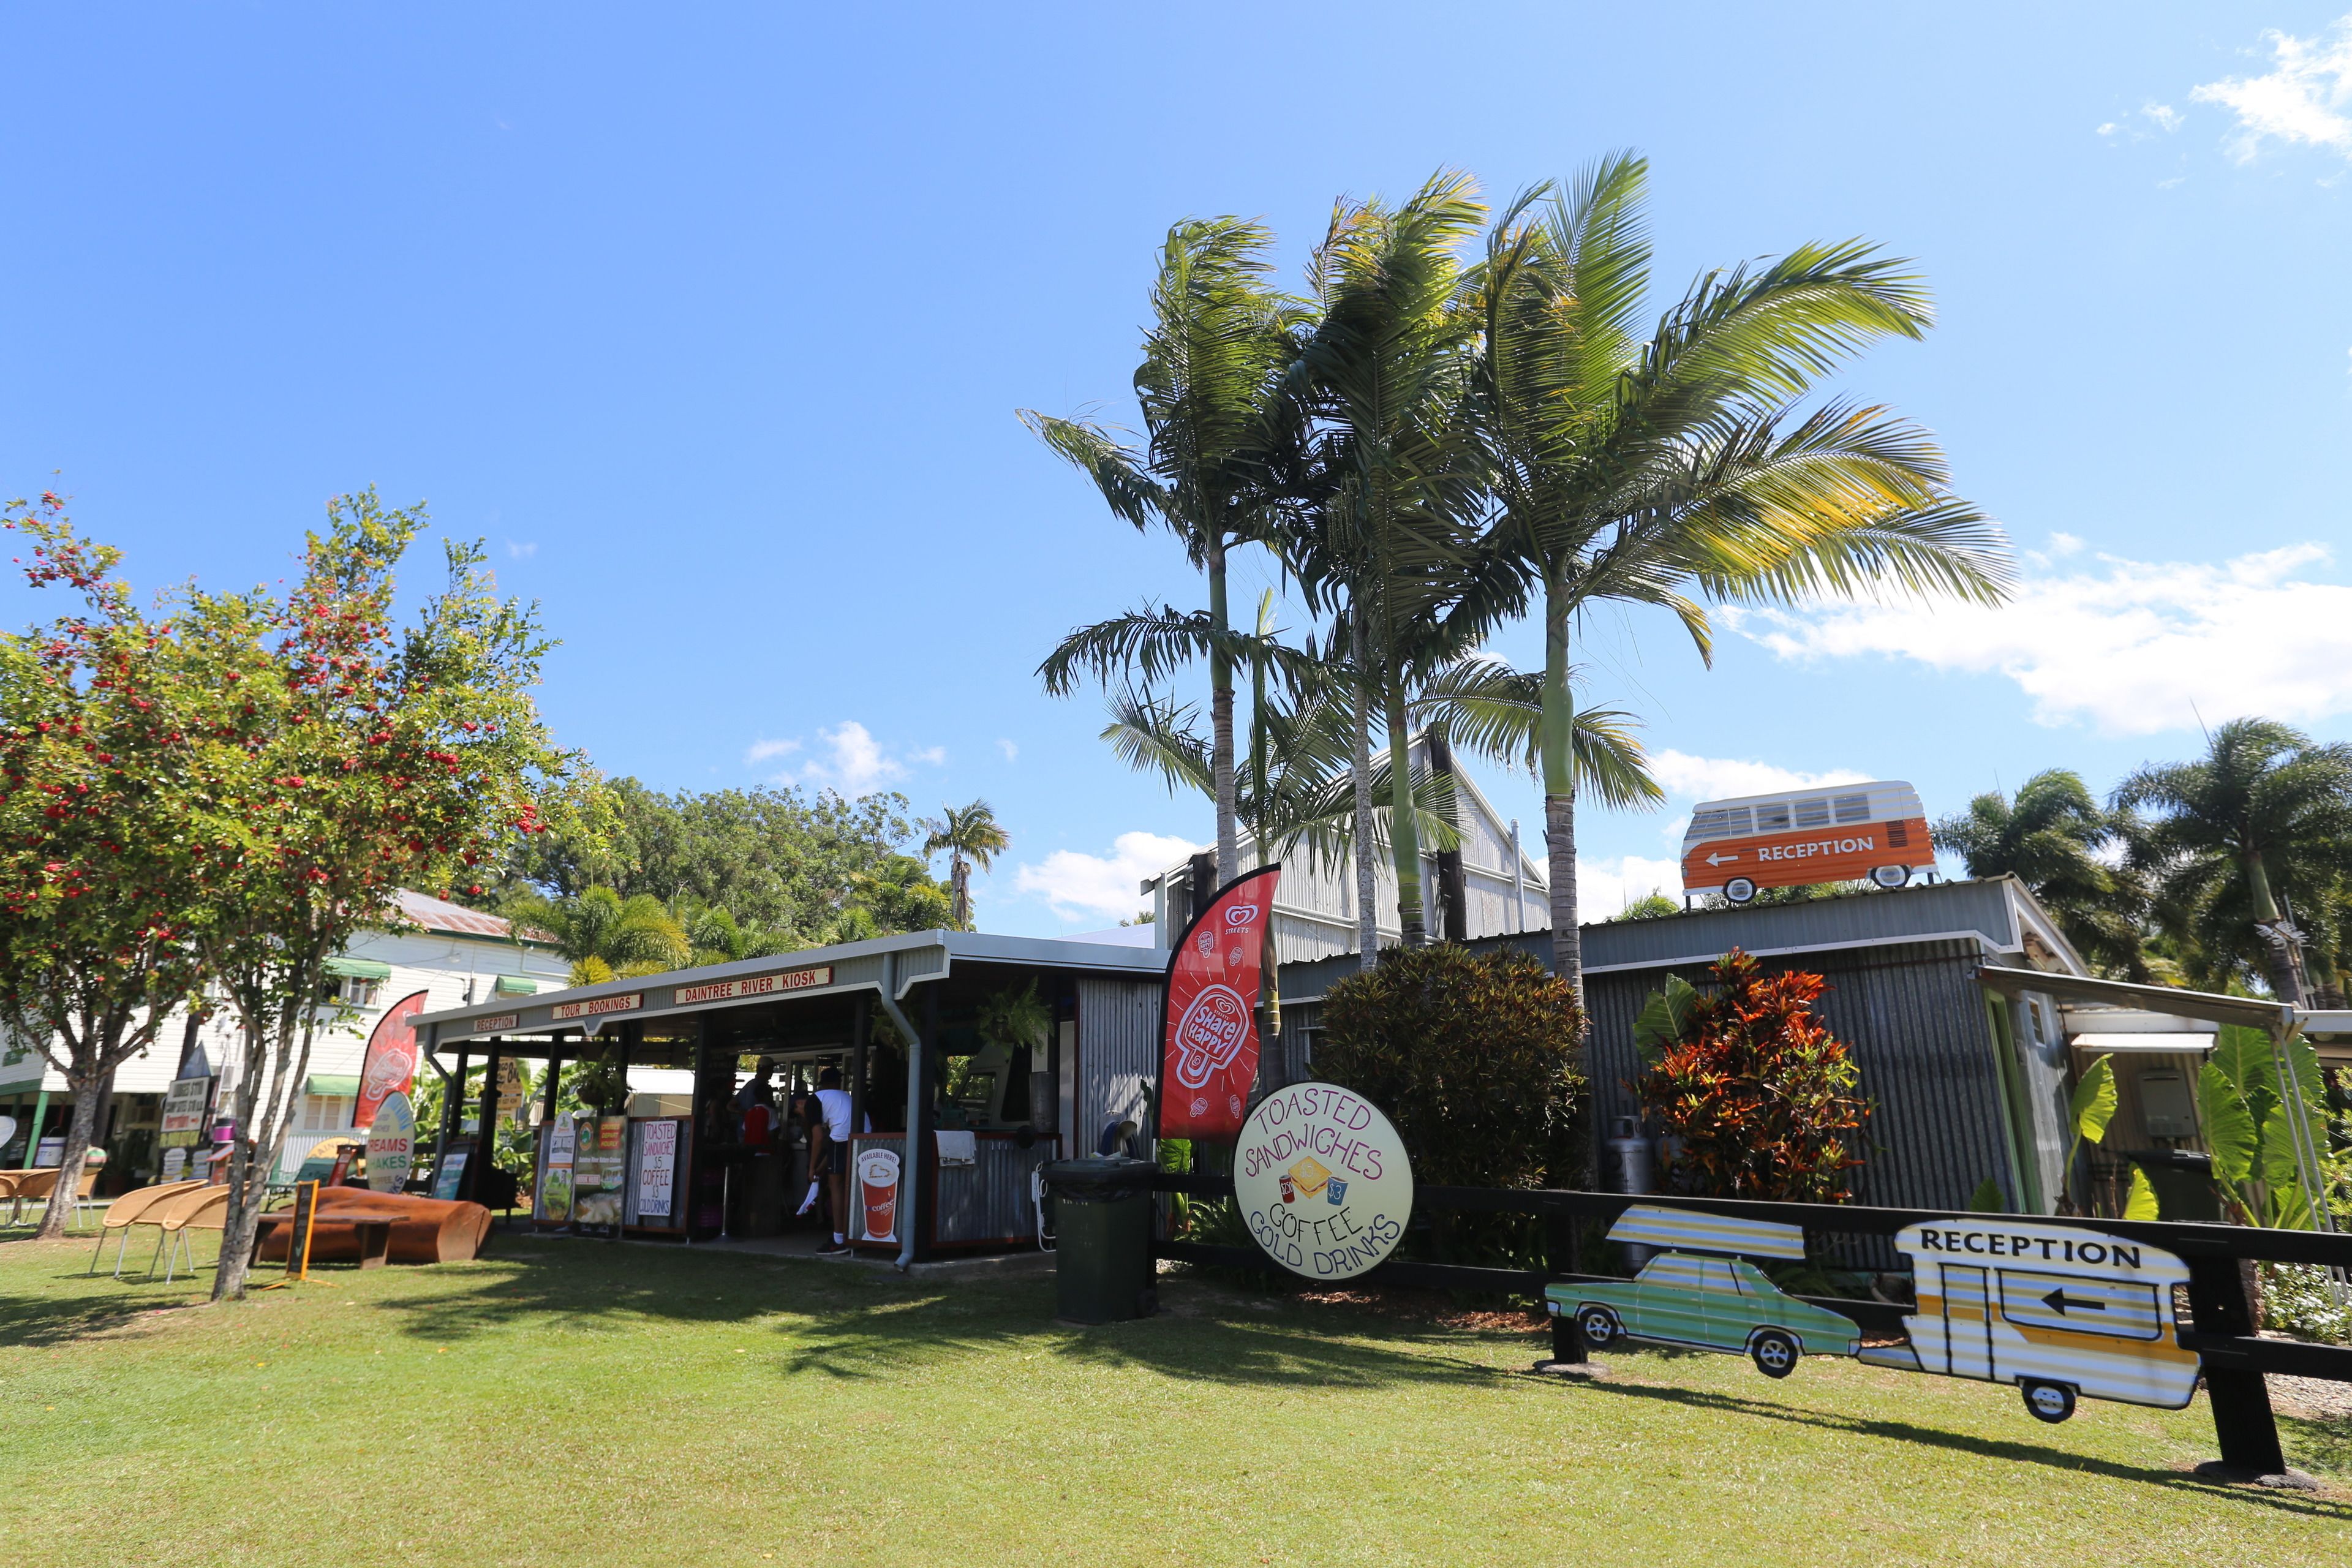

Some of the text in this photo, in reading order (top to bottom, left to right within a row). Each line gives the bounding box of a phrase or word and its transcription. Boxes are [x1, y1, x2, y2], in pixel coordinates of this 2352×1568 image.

[1757, 836, 1874, 862] RECEPTION
[685, 971, 816, 1001] DAINTREE RIVER KIOSK
[561, 997, 630, 1017] TOUR BOOKINGS
[1214, 1009, 1229, 1020] STREETS
[477, 1017, 513, 1030] RECEPTION
[1253, 1088, 1371, 1134] TOASTED
[646, 1123, 676, 1140] TOASTED
[644, 1140, 674, 1156] SANDWICHES
[1245, 1123, 1382, 1180] SANDWICHES
[861, 1152, 897, 1164] AVAILABLE HERE!
[643, 1169, 669, 1186] COFFEE
[1328, 1183, 1342, 1200] $3
[639, 1198, 669, 1214] COLD DRINKS
[872, 1199, 894, 1212] coffee
[1270, 1203, 1363, 1245] COFFEE
[1250, 1211, 1400, 1275] COLD DRINKS
[1920, 1229, 2141, 1269] RECEPTION
